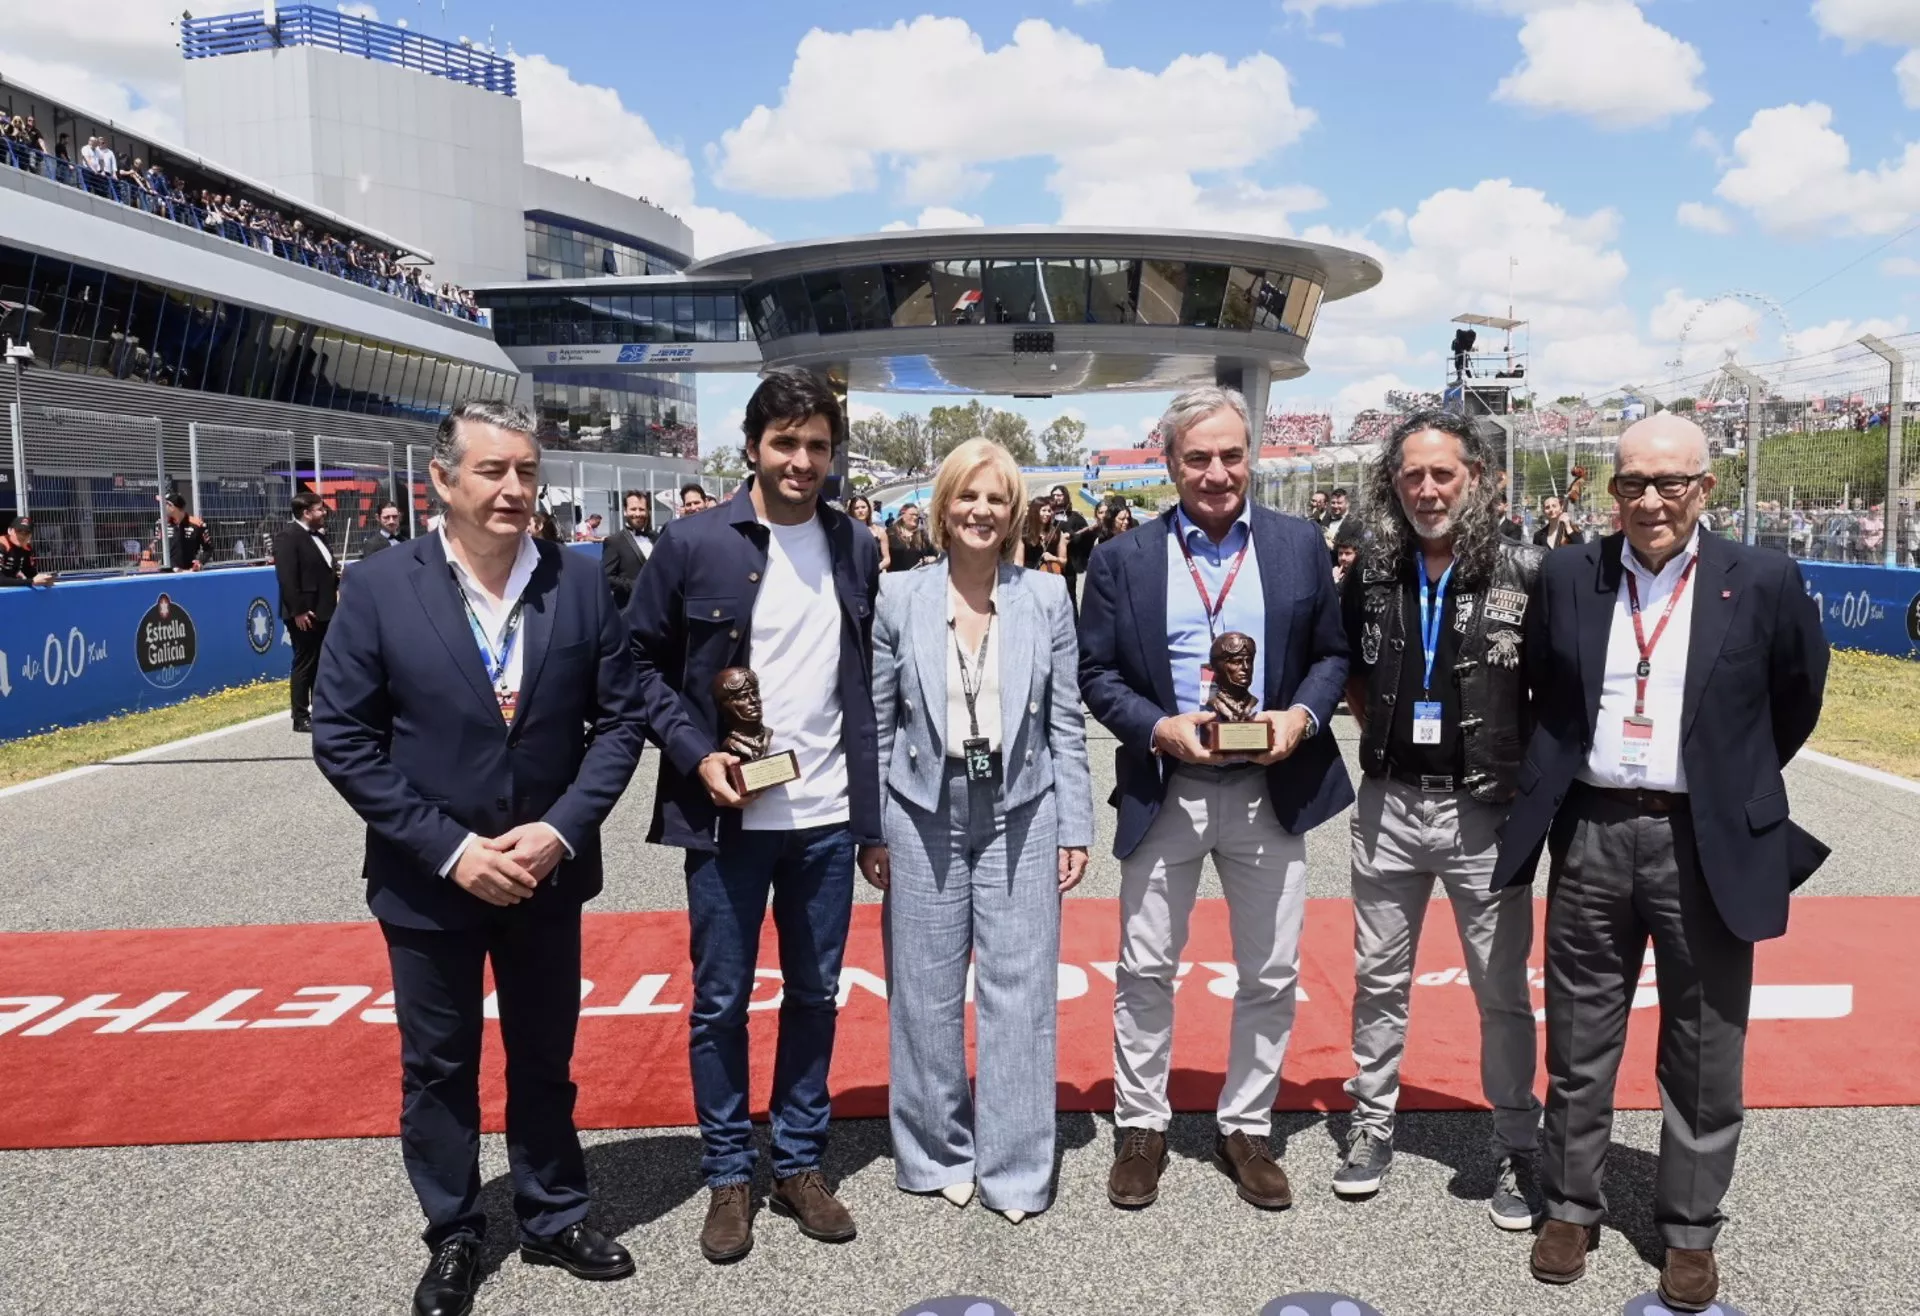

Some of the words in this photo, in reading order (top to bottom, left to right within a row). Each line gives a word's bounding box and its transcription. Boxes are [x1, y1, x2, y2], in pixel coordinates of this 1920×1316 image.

[657, 348, 694, 356] JEREZ
[1842, 590, 1870, 629] 0,0
[145, 619, 187, 643] Estrella
[44, 626, 85, 686] 0,0
[148, 640, 187, 665] Galicia
[972, 754, 990, 770] 75
